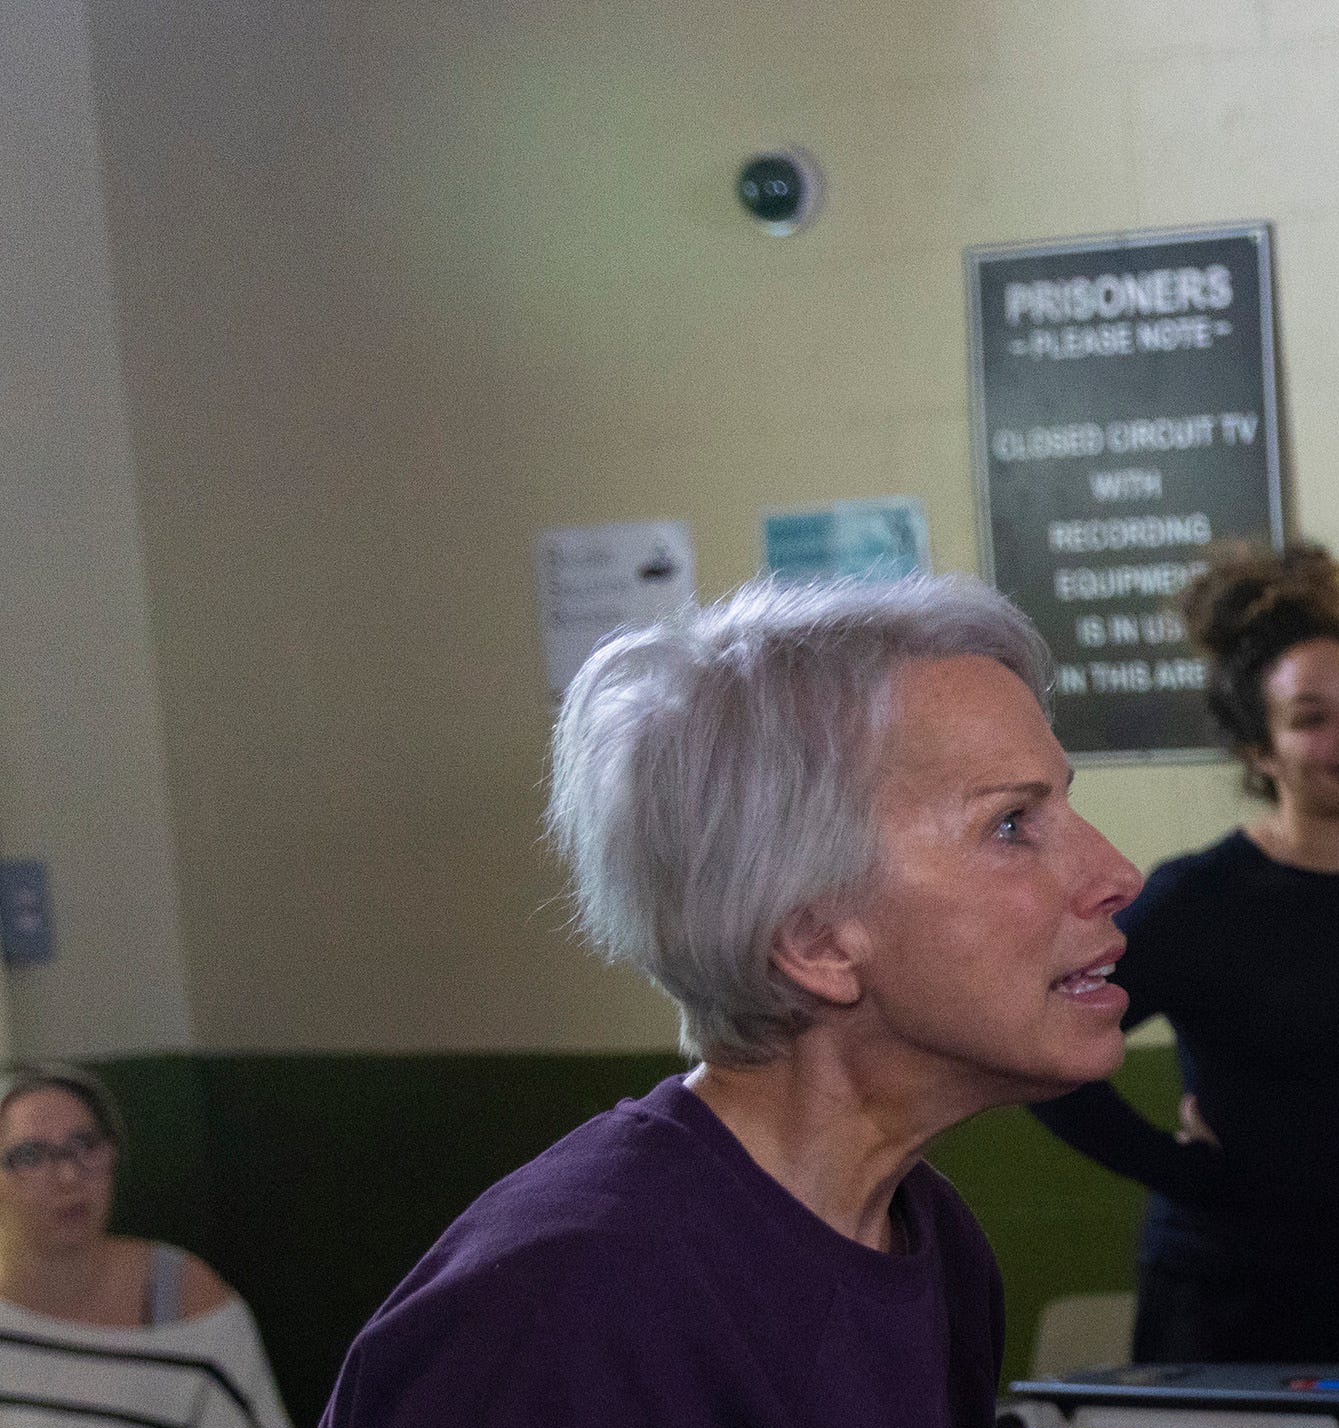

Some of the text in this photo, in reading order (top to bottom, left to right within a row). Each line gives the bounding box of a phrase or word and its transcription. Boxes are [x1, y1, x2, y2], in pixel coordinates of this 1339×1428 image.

[1004, 265, 1232, 325] PRISONERS
[993, 412, 1258, 461] CLOSED CIRCUIT TV
[1090, 468, 1162, 501] WITH
[1048, 512, 1211, 552] RECORDING
[1076, 610, 1183, 647] IS IN US
[1057, 657, 1207, 695] IN THIS ARE
